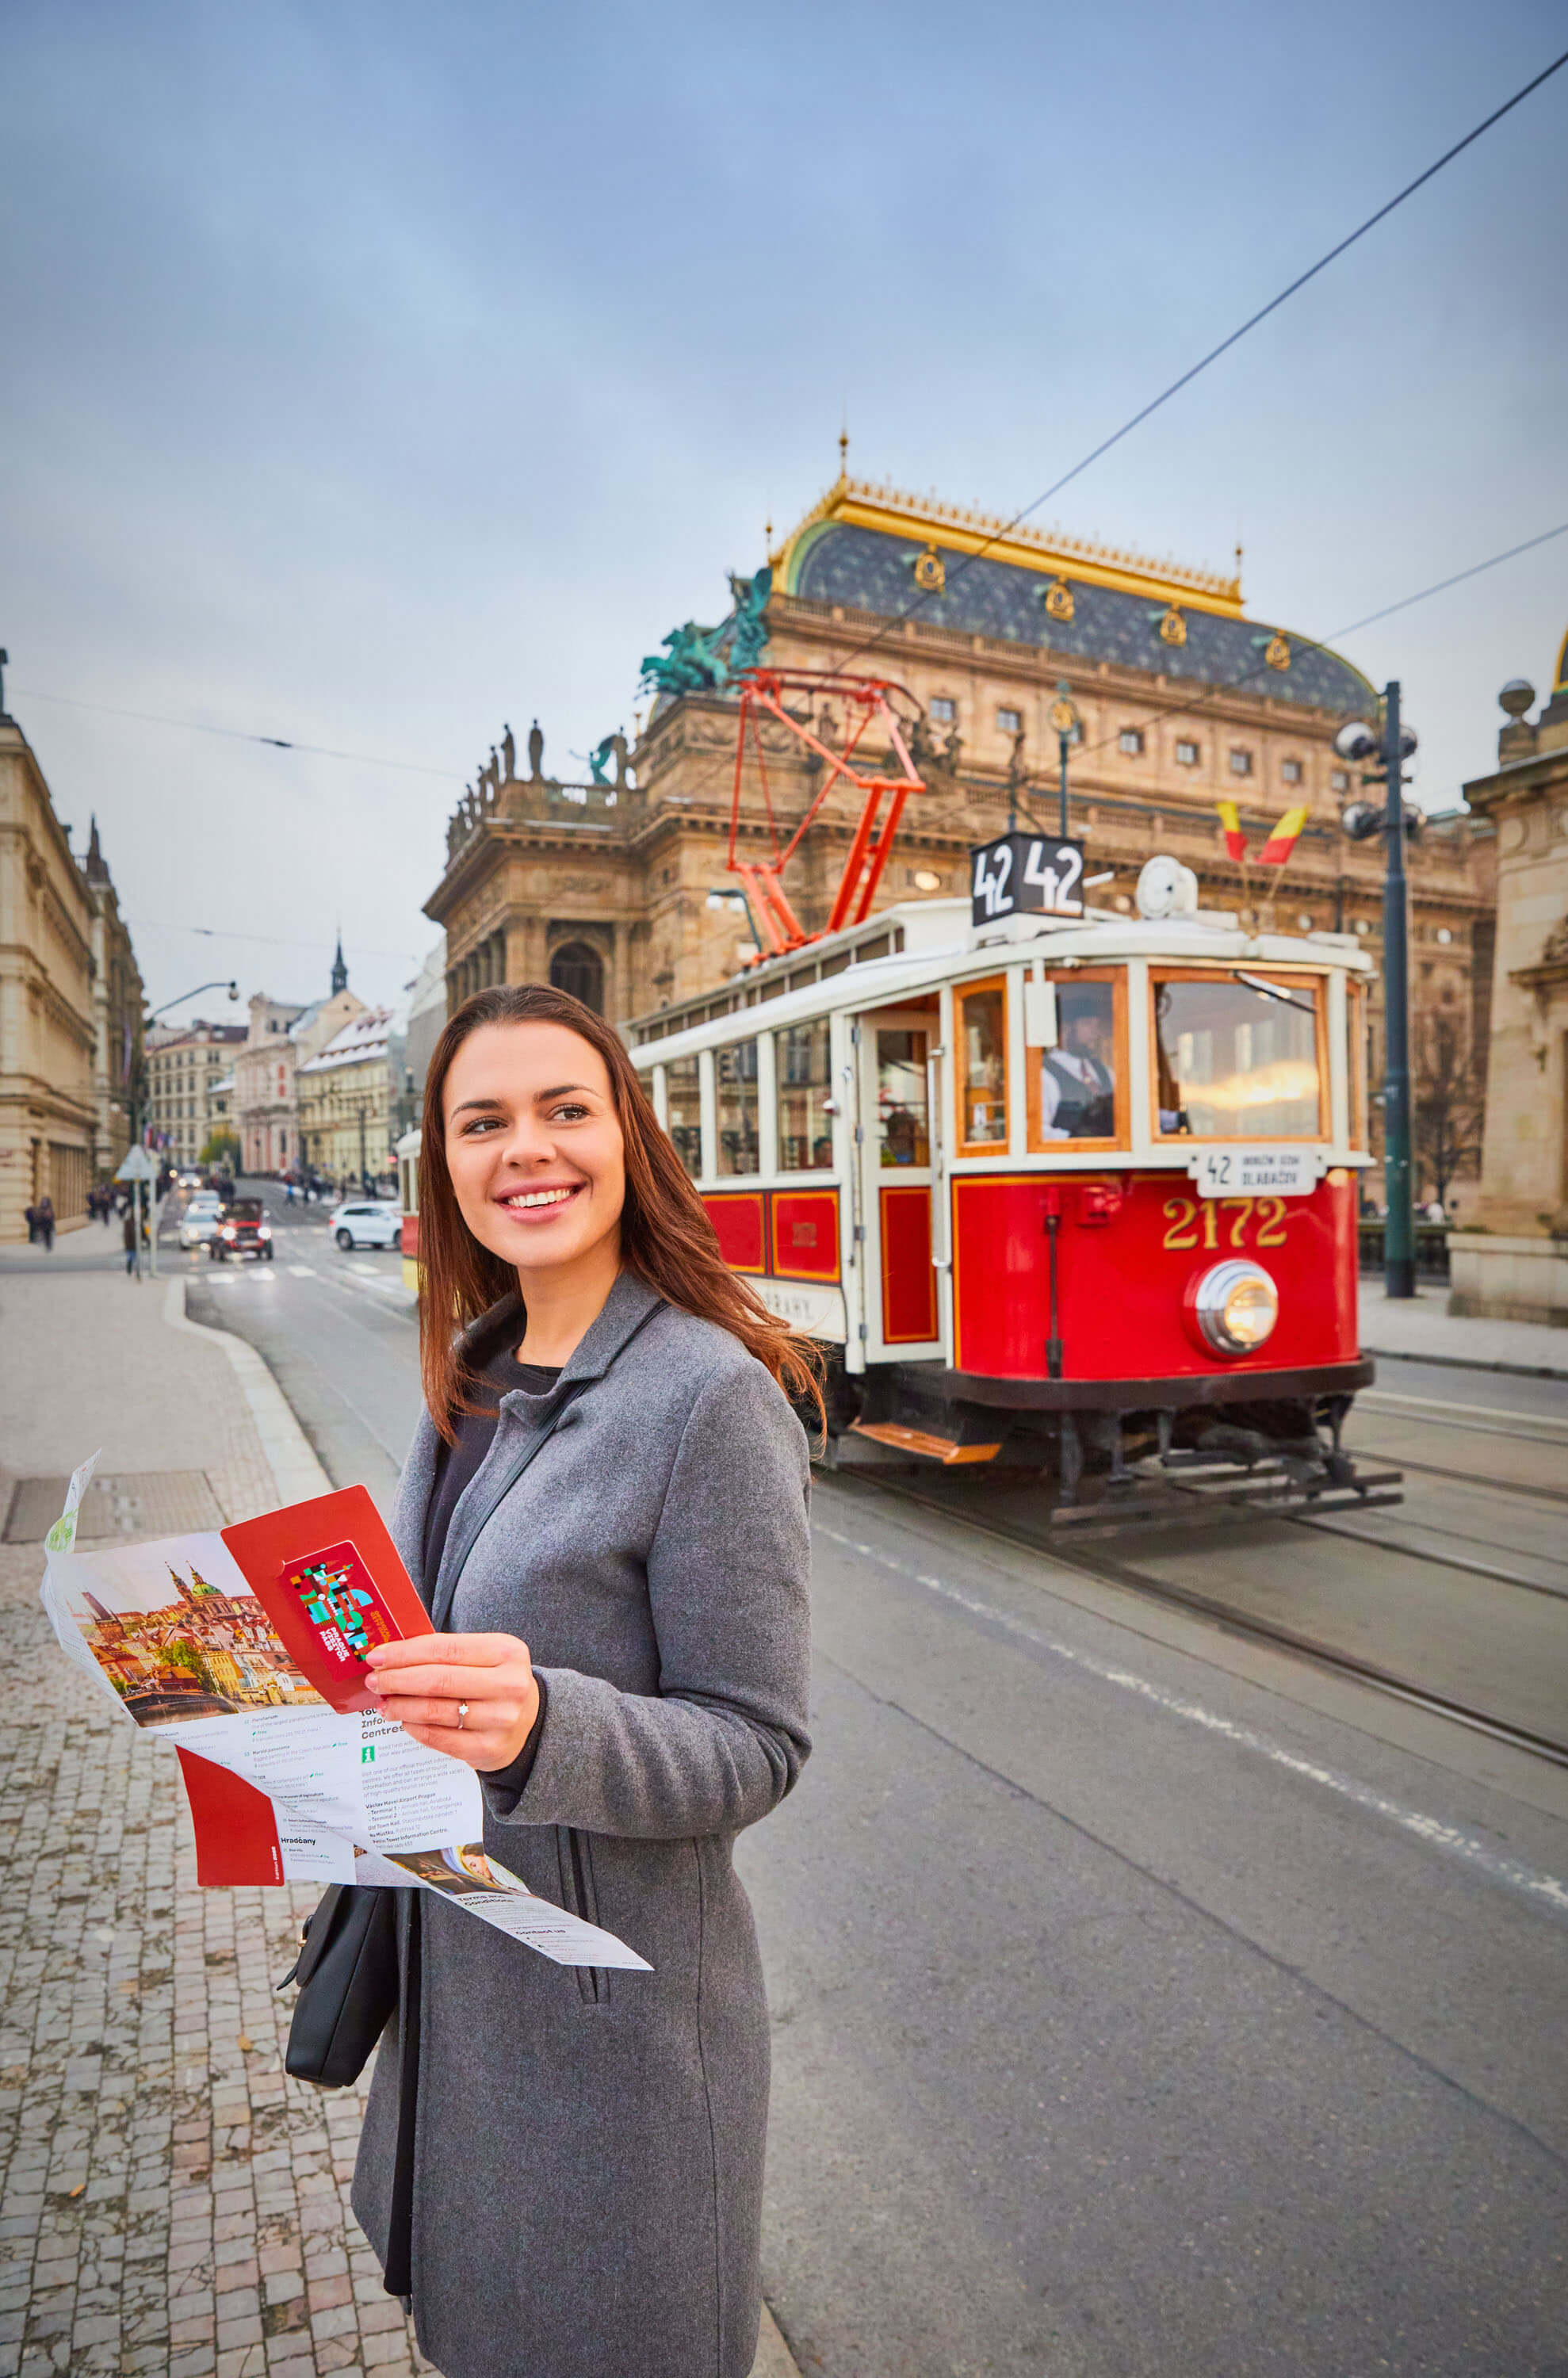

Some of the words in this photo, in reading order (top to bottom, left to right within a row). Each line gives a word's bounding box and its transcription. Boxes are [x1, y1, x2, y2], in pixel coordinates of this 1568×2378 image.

[973, 844, 1013, 916] 42
[1023, 840, 1083, 914] 42
[1207, 1156, 1230, 1184] 42
[1163, 1197, 1288, 1249] 2172
[319, 1631, 334, 1652] PASS
[325, 1629, 346, 1662] VISITOR
[330, 1627, 350, 1658] PRAGUE
[361, 1725, 406, 1740] Centres
[281, 1837, 316, 1845] Hradčany
